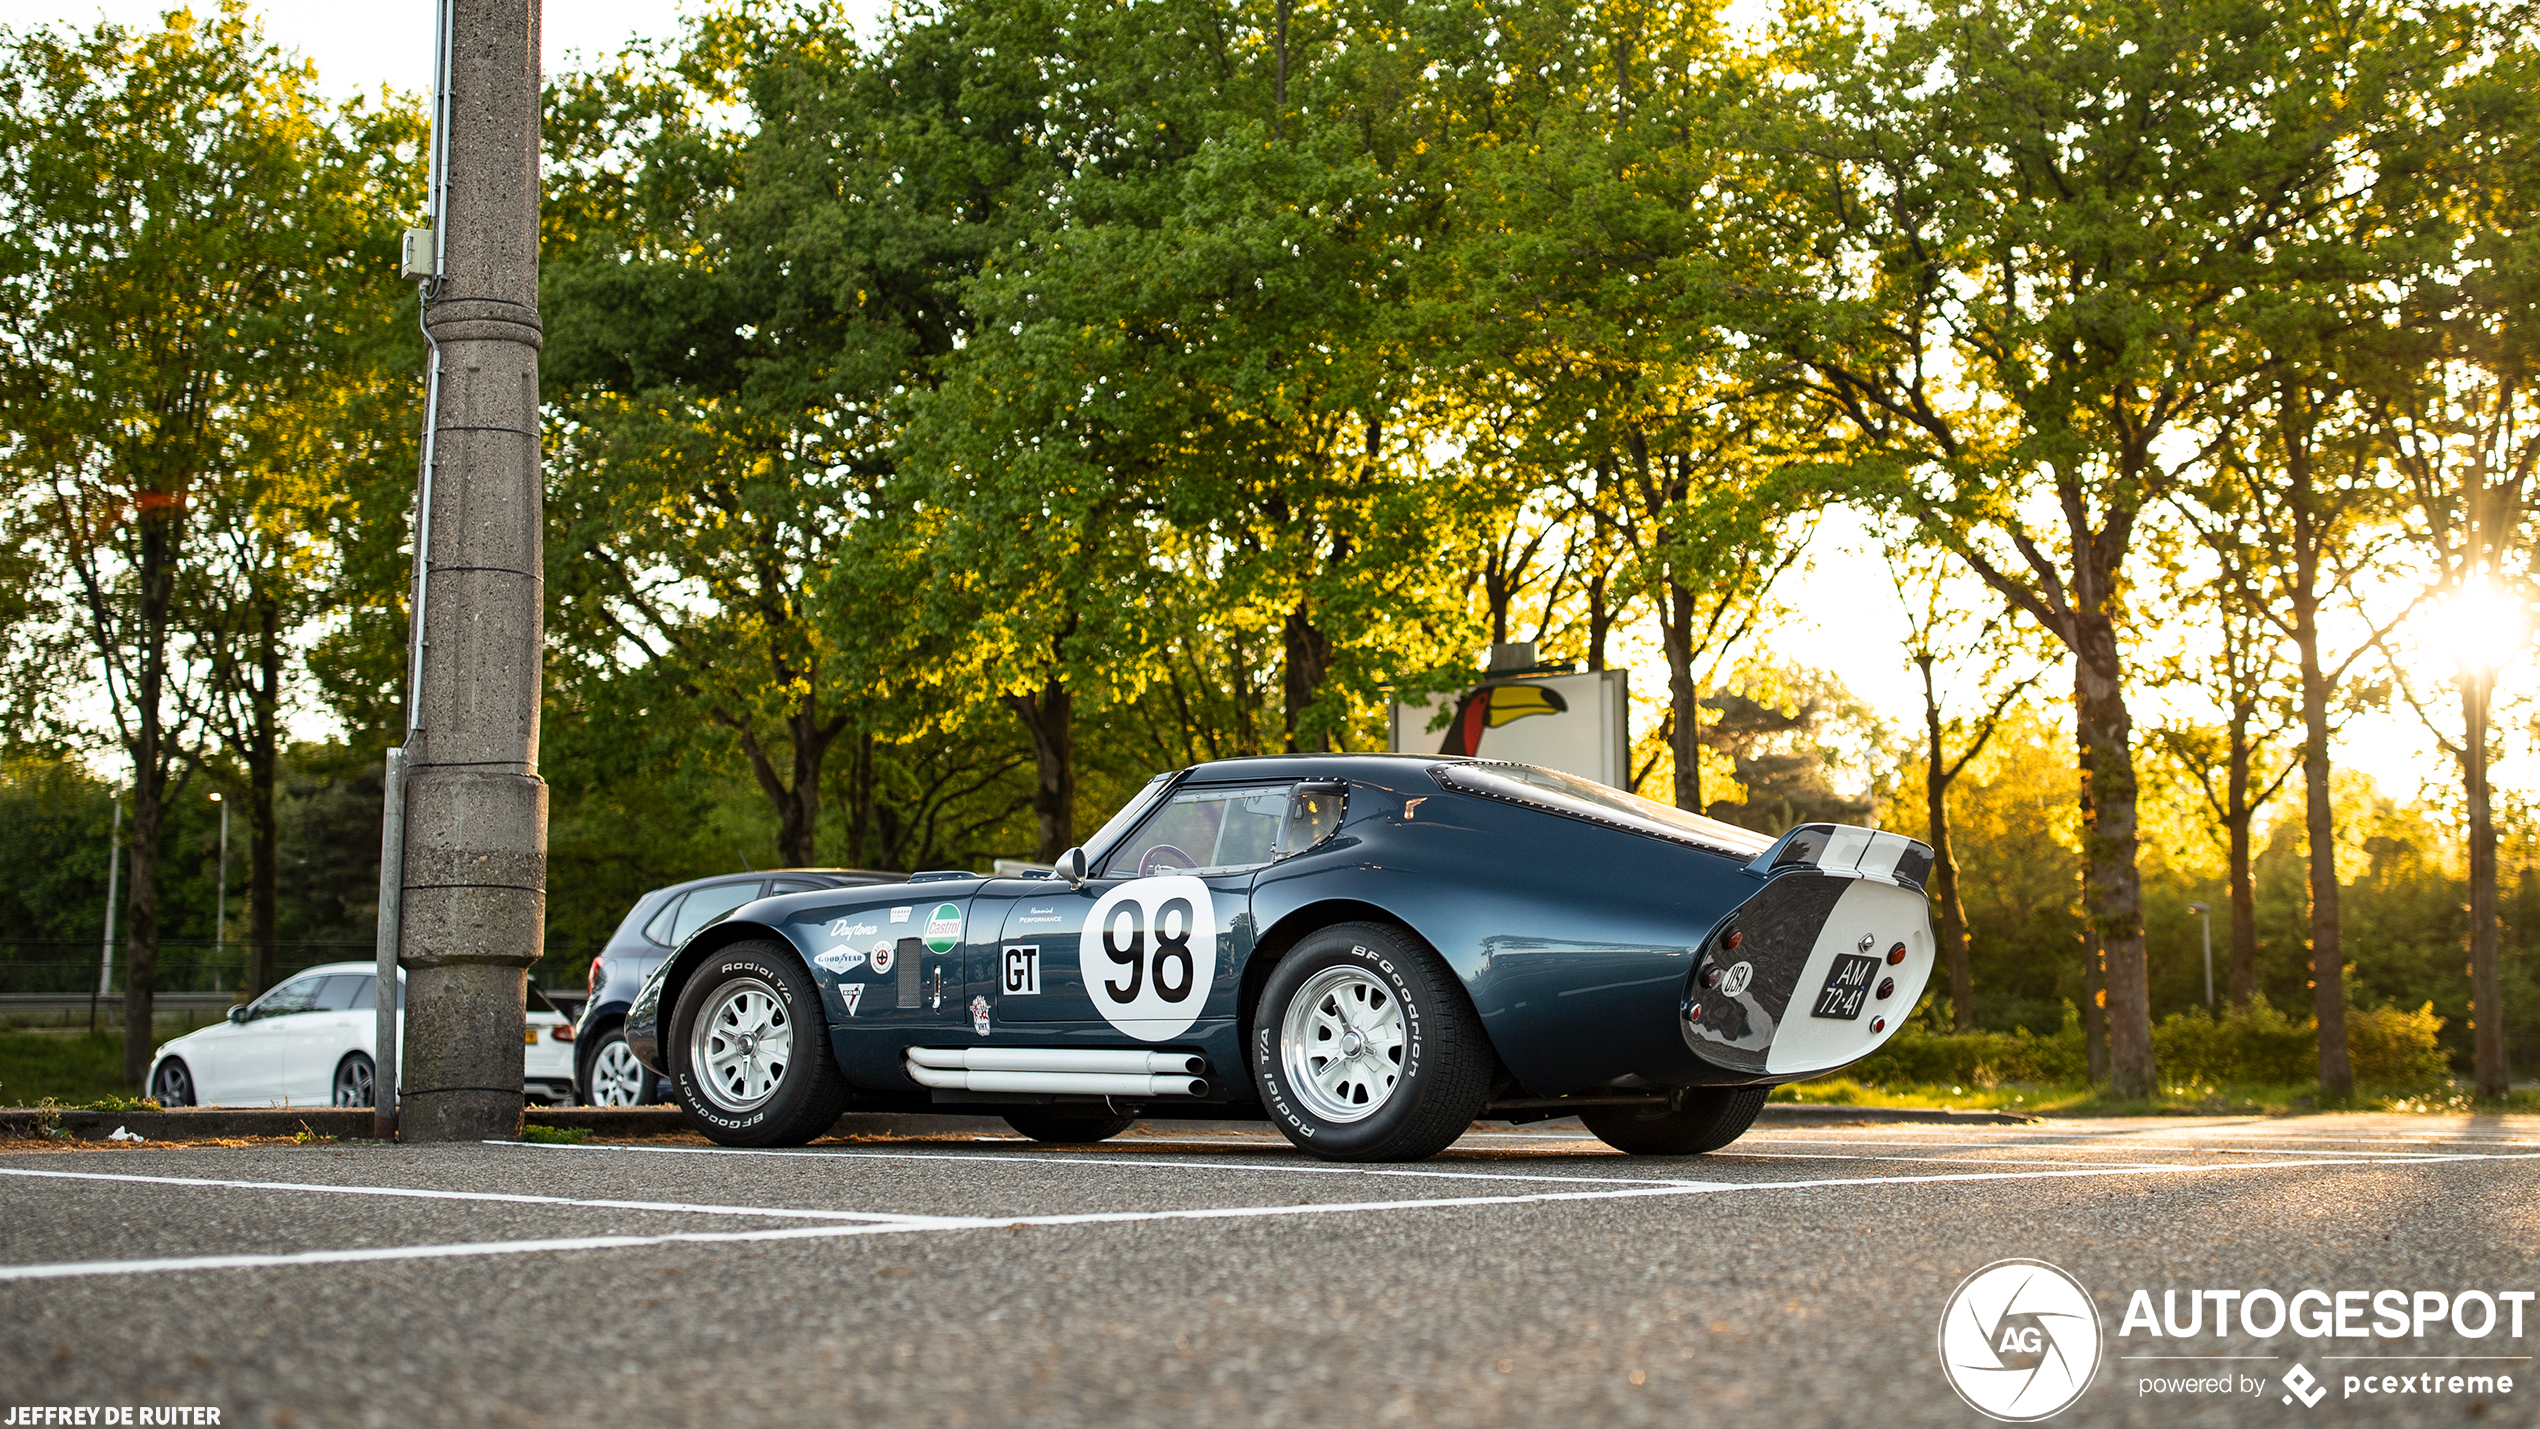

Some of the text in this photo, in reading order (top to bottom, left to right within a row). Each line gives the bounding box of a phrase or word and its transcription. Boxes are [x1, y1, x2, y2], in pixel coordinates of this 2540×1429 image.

[830, 919, 878, 941] Daytona
[928, 920, 960, 935] Castrol
[818, 953, 863, 964] GOODYEAR
[1102, 896, 1194, 1004] 98
[721, 961, 793, 1005] Radial T/A
[1005, 948, 1036, 992] GT
[1723, 966, 1751, 992] USA
[1836, 959, 1871, 986] AM
[1351, 944, 1423, 1078] BFGoodrich
[1819, 987, 1863, 1015] 72-41
[679, 1072, 764, 1129] BFGoodrich
[1260, 1028, 1315, 1138] Radial T/A
